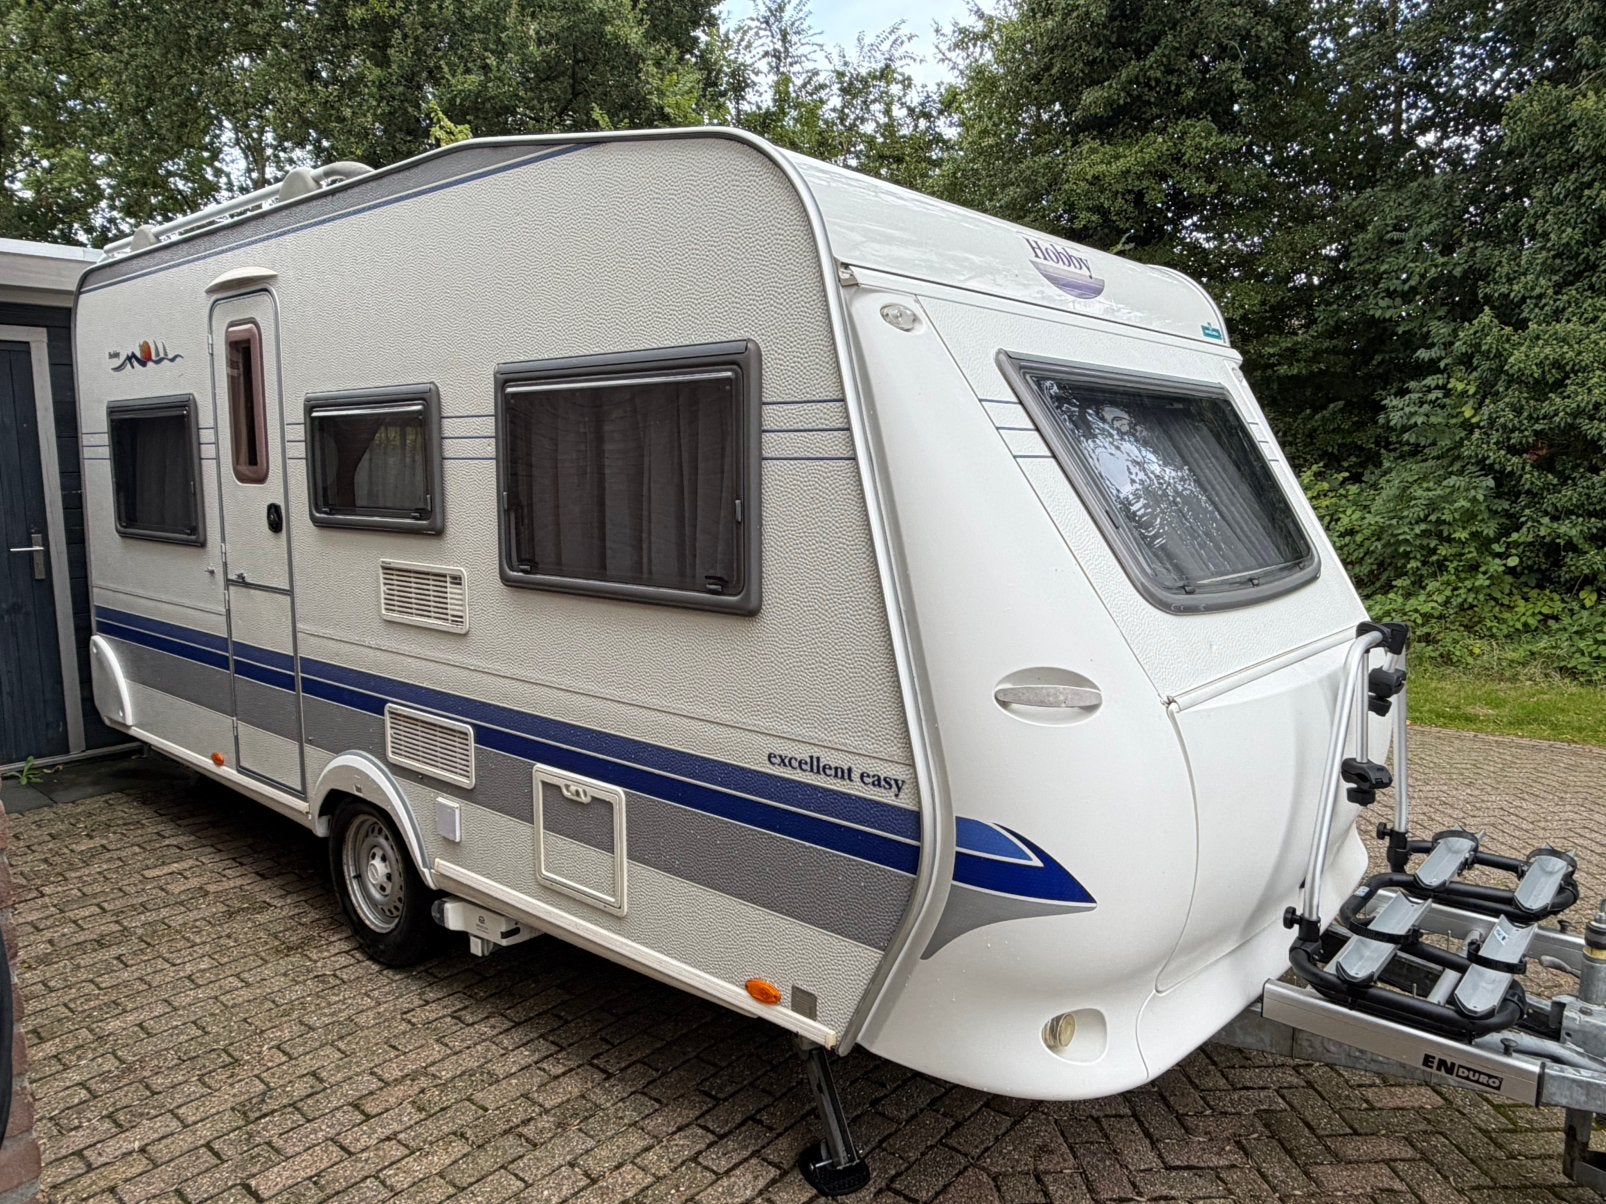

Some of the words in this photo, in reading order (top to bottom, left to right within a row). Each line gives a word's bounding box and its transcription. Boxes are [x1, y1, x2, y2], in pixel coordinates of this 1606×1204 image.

[1025, 237, 1093, 279] Hobby
[767, 752, 853, 782] excellent
[859, 770, 905, 797] easy
[1422, 1053, 1503, 1090] ENDURO
